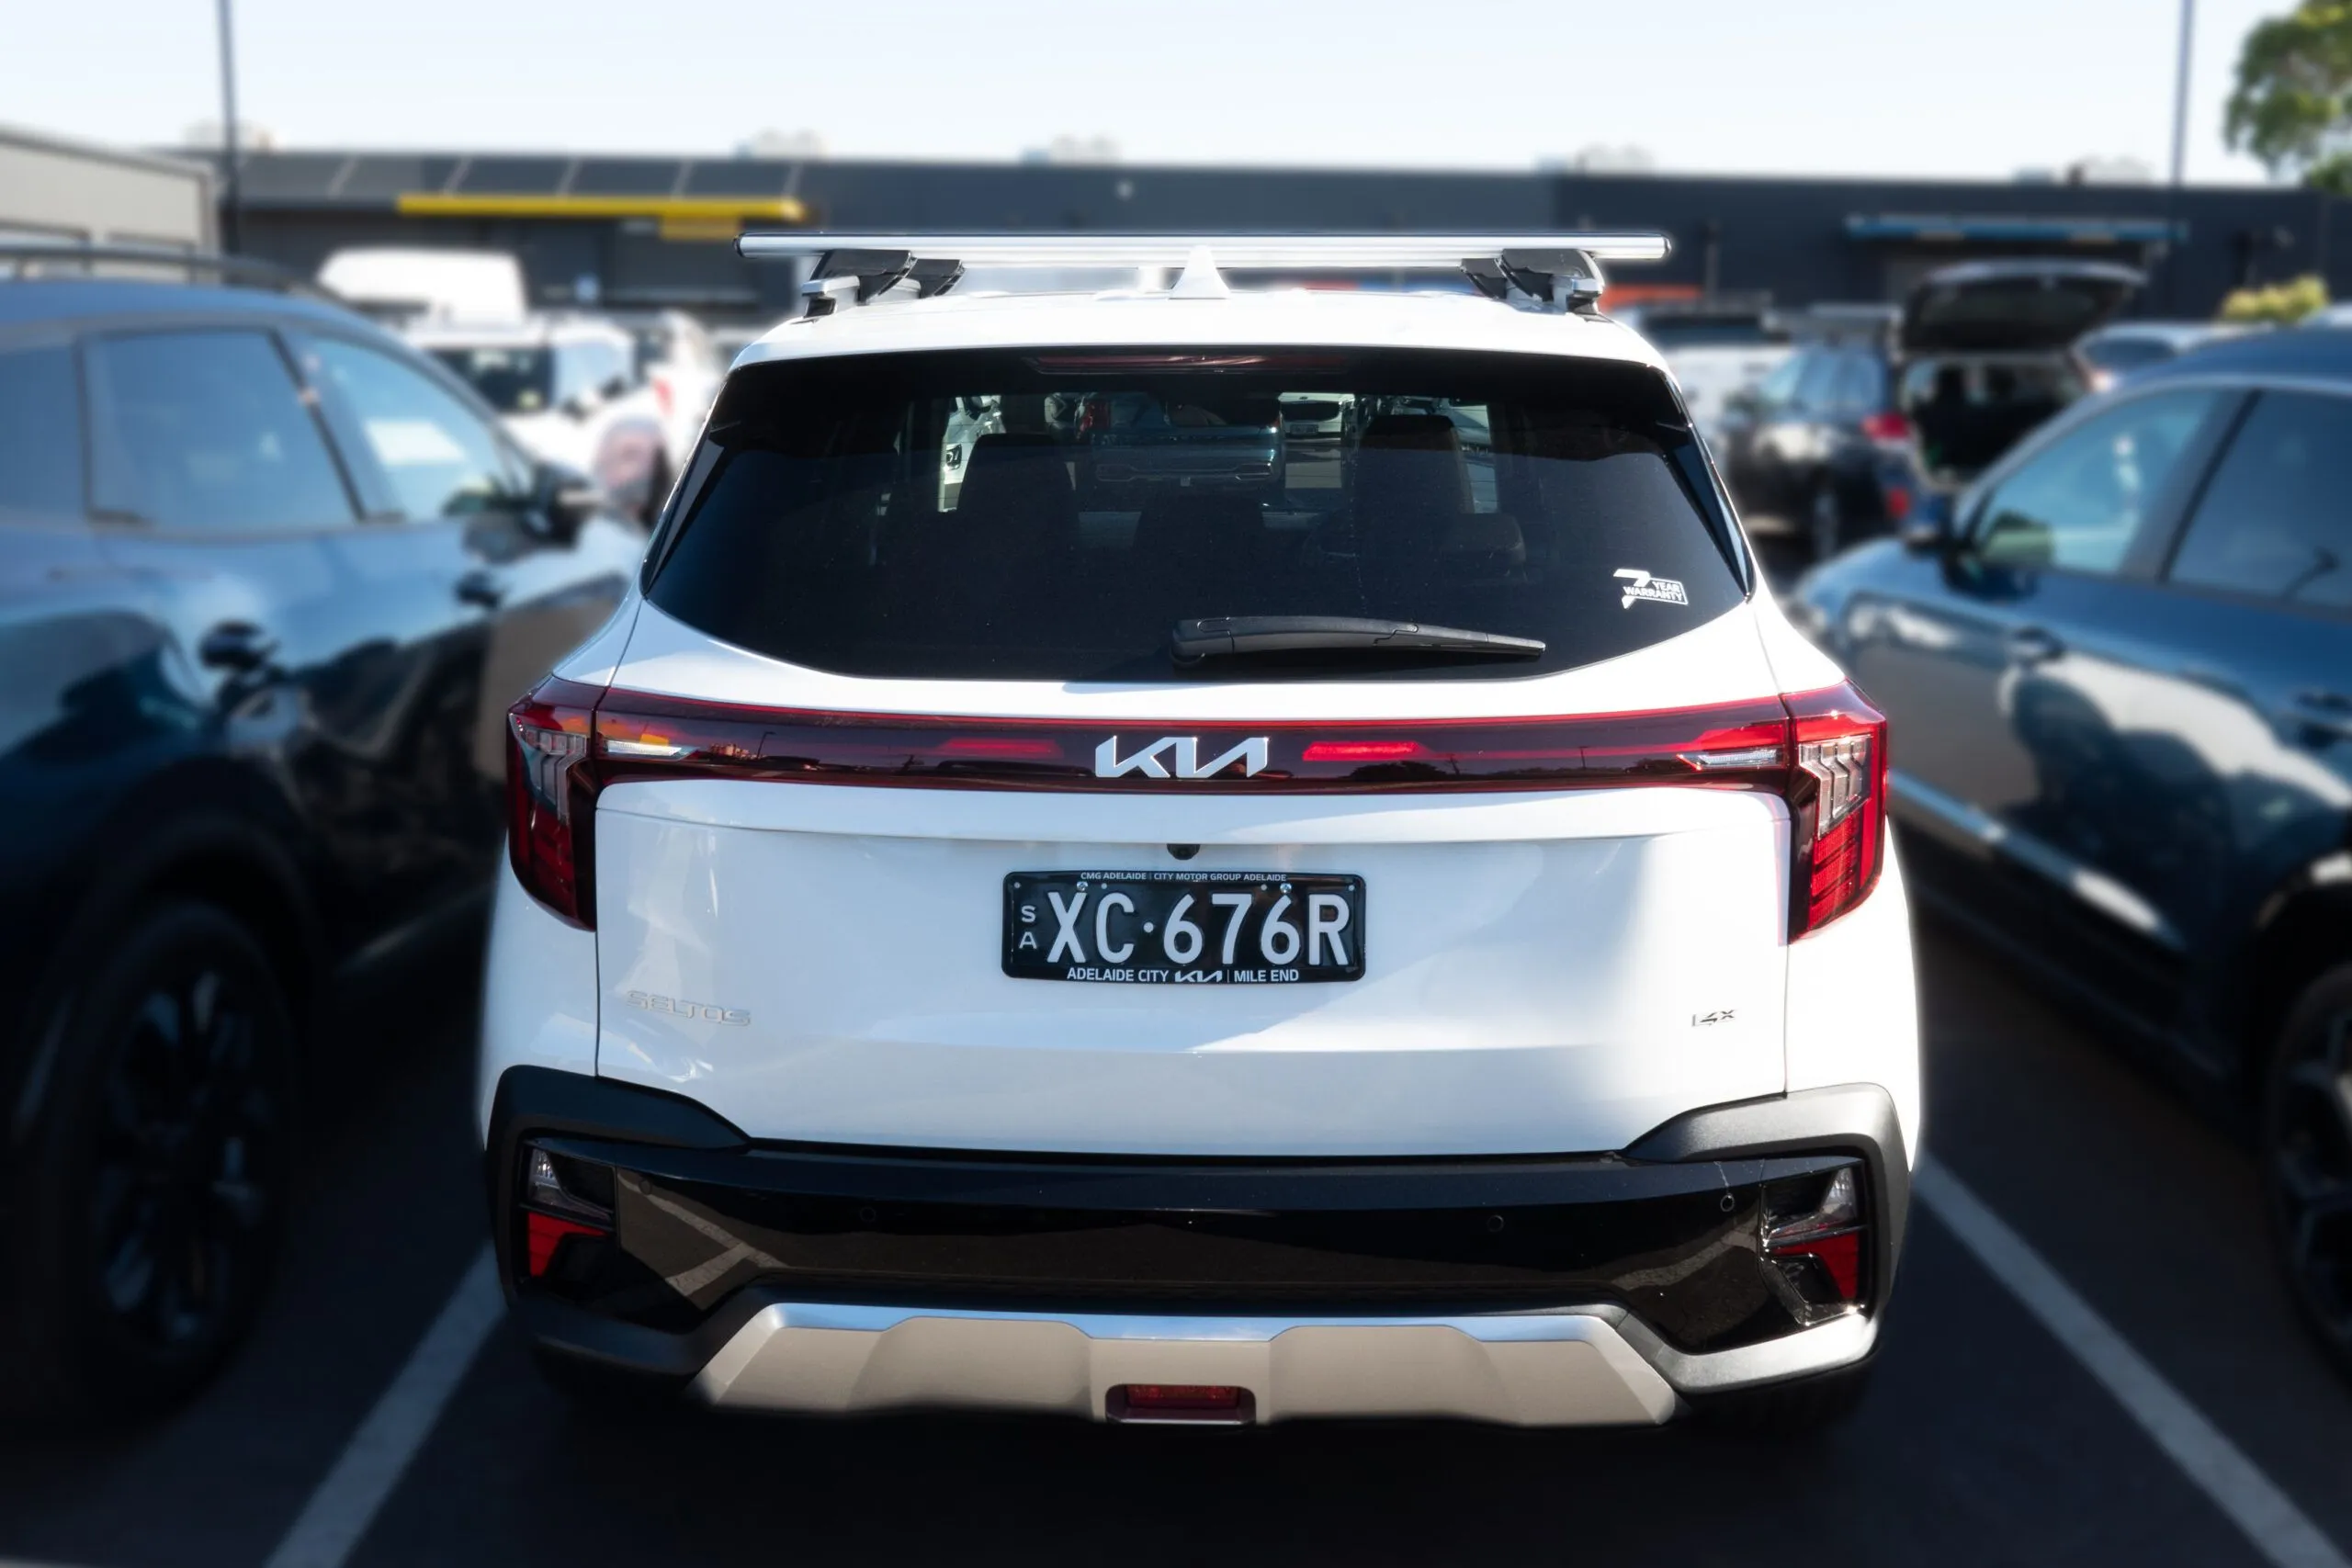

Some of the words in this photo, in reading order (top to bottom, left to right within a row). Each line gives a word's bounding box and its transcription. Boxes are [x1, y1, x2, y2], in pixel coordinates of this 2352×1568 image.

[1623, 586, 1682, 602] WARRANTY
[1652, 581, 1680, 592] YEAR
[1095, 735, 1269, 778] KIA
[1080, 872, 1102, 880] CMG
[1102, 872, 1147, 880] ADELAIDE
[1176, 873, 1208, 881] MOTOR
[1210, 873, 1241, 881] GROUP
[1243, 874, 1287, 882] ADELAIDE
[1067, 967, 1135, 982] ADELAIDE
[1137, 969, 1170, 982] CITY
[1174, 970, 1223, 982] KIA
[1234, 969, 1266, 982] MILE
[1271, 969, 1299, 982] END
[627, 990, 751, 1026] SELTOS
